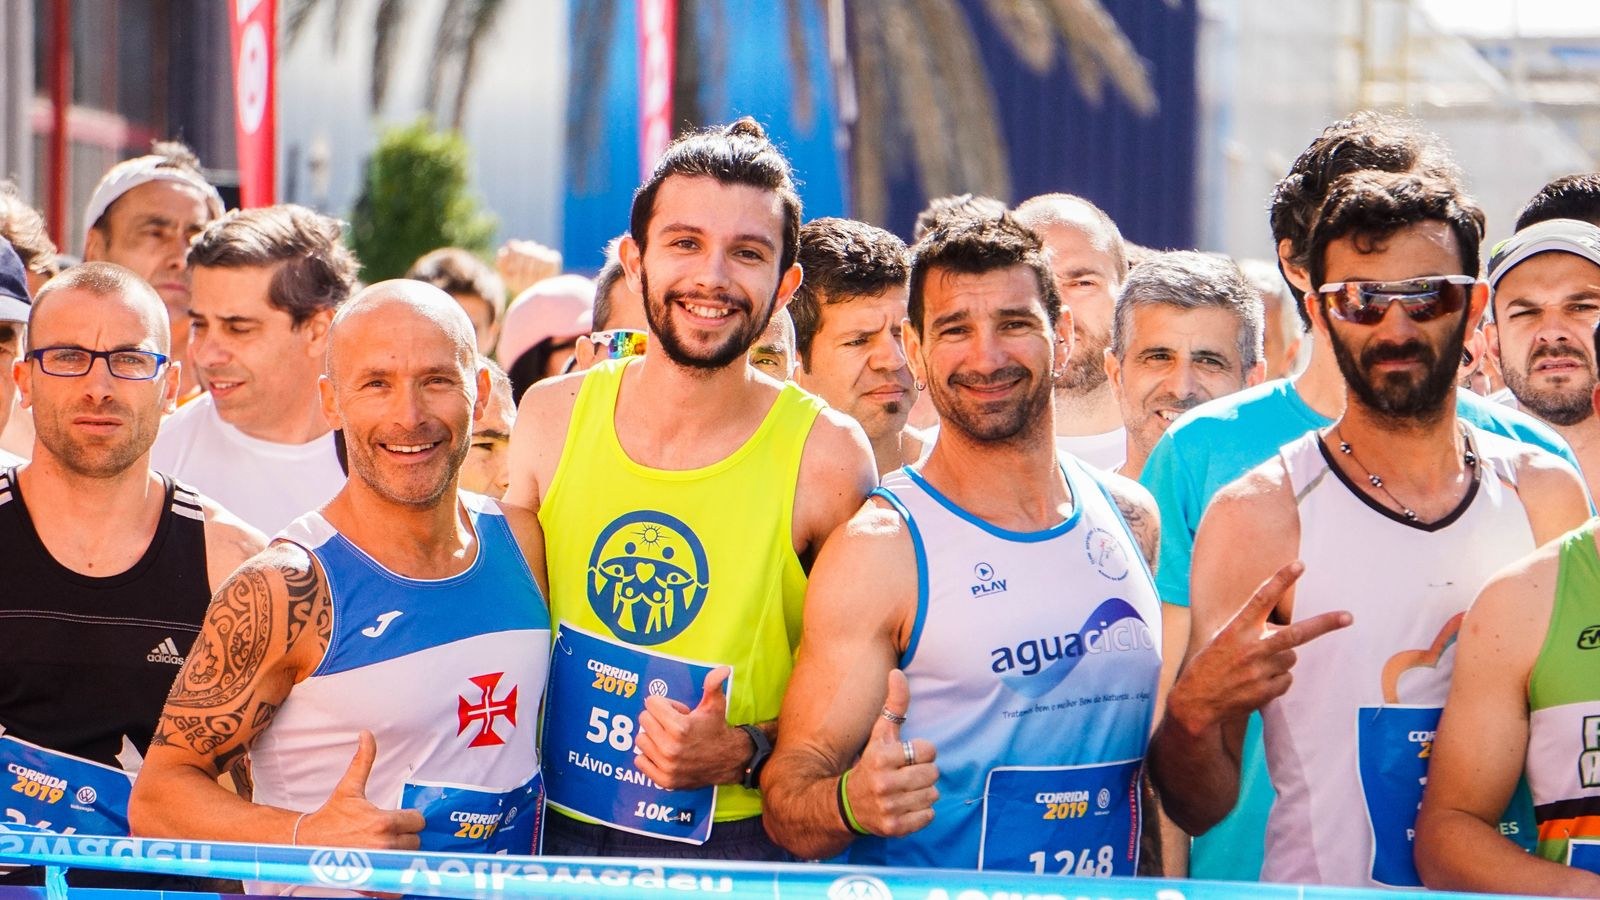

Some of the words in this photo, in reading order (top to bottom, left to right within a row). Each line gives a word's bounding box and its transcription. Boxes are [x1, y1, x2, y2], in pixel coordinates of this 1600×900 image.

[971, 579, 1007, 595] PLAY
[146, 652, 184, 666] adidas
[587, 659, 639, 684] CORRIDA
[591, 673, 638, 699] 2019
[585, 706, 642, 755] 58
[7, 763, 68, 791] CORRIDA
[568, 750, 613, 777] FLÁVIO
[614, 766, 675, 792] SANT
[11, 775, 64, 804] 2019
[1035, 788, 1090, 804] CORRIDA
[634, 801, 674, 823] 10K
[680, 811, 692, 822] M
[1043, 801, 1088, 820] 2019
[1029, 845, 1114, 879] 1248
